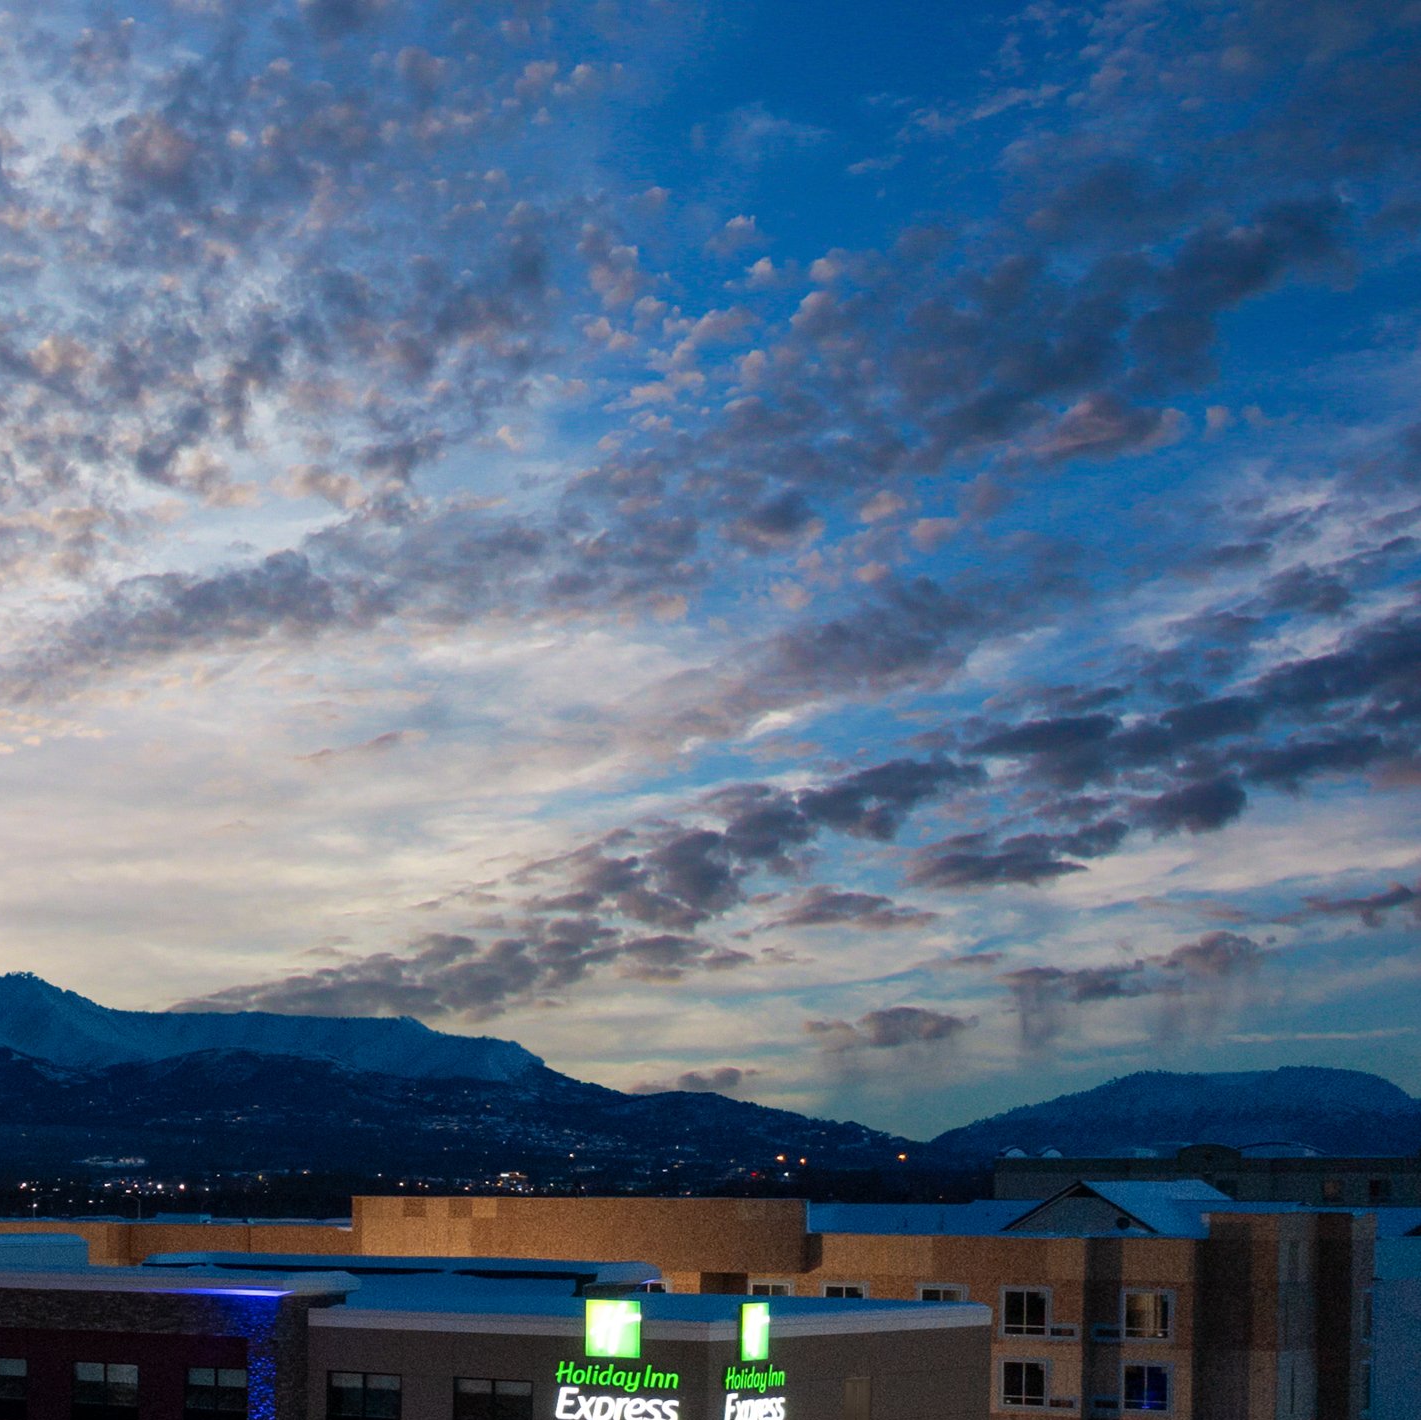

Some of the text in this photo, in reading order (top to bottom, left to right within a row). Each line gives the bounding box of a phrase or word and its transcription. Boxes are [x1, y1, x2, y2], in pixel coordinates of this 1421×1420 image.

[556, 1361, 679, 1393] Holiday Inn
[725, 1364, 786, 1393] Holiday Inn
